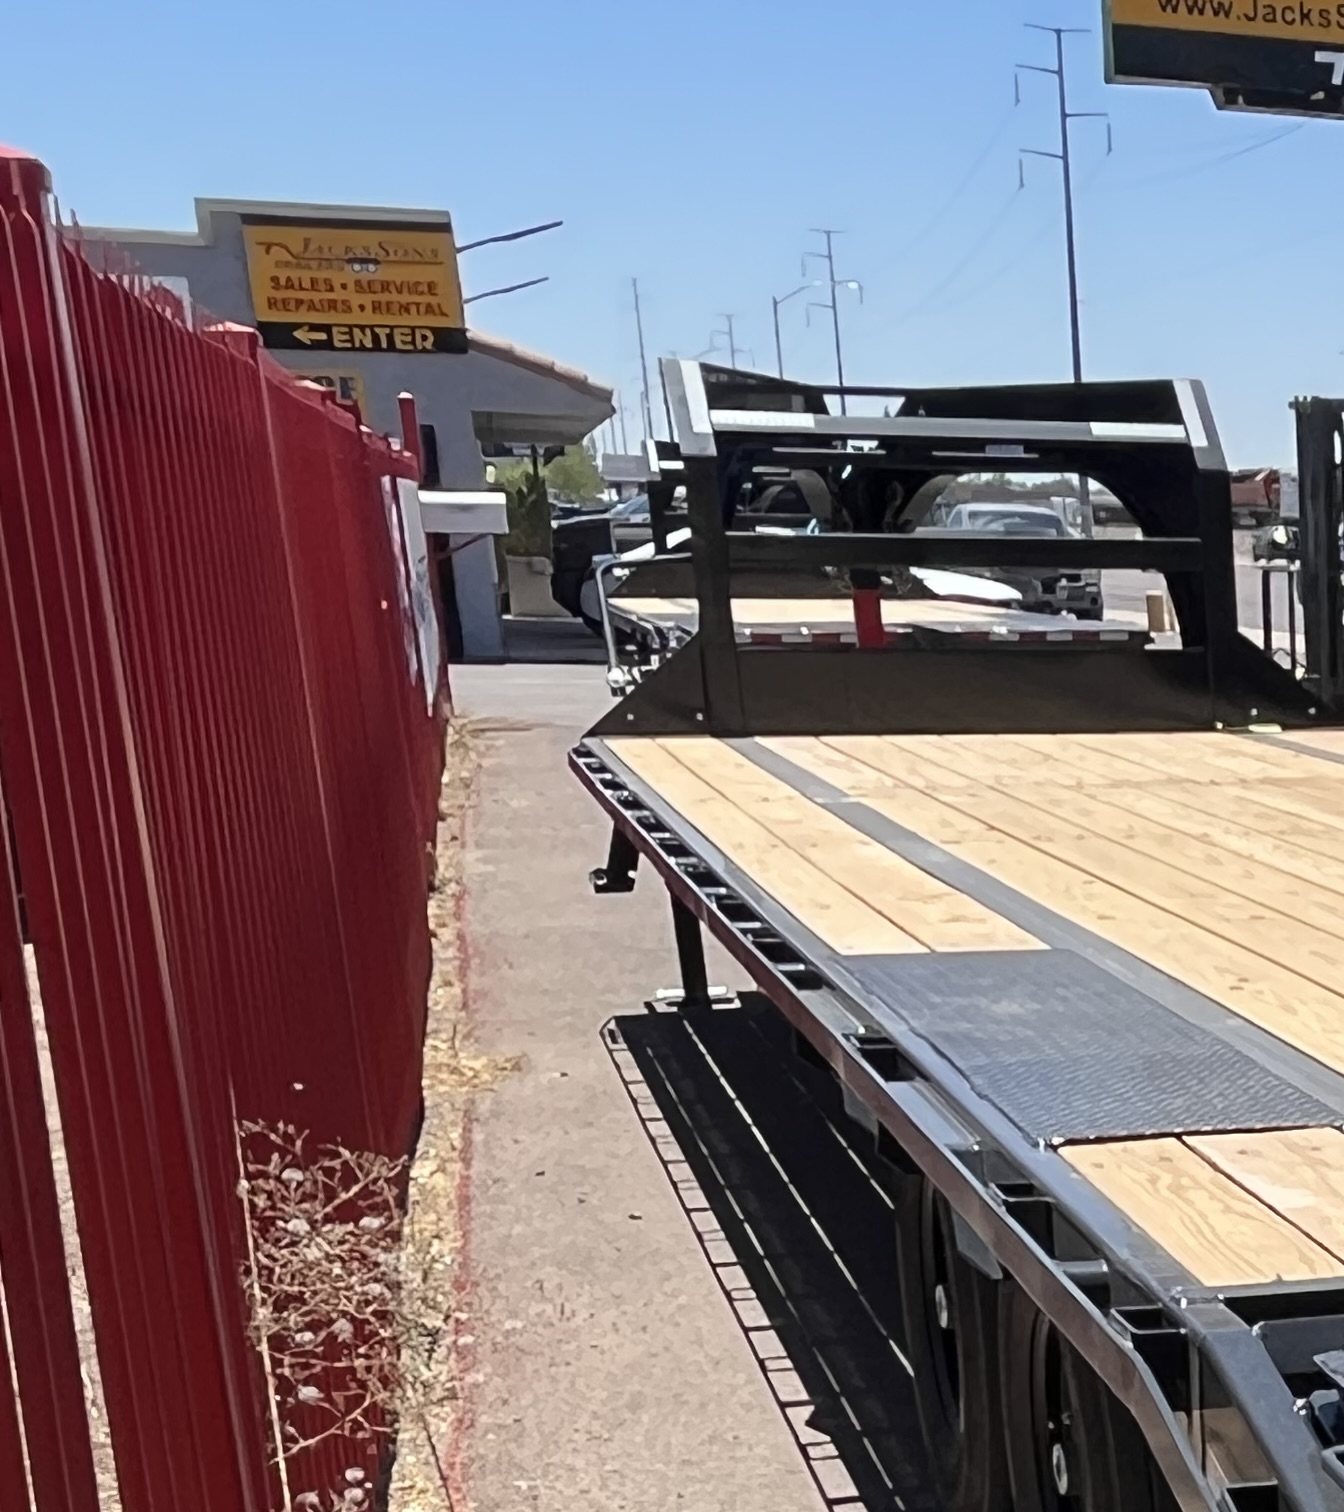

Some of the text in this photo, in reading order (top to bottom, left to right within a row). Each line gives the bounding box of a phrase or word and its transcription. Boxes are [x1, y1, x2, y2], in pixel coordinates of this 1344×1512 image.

[270, 275, 440, 297] SALES SERVICE
[267, 296, 450, 318] REPAIRS RENTAL
[331, 325, 435, 350] ENTER
